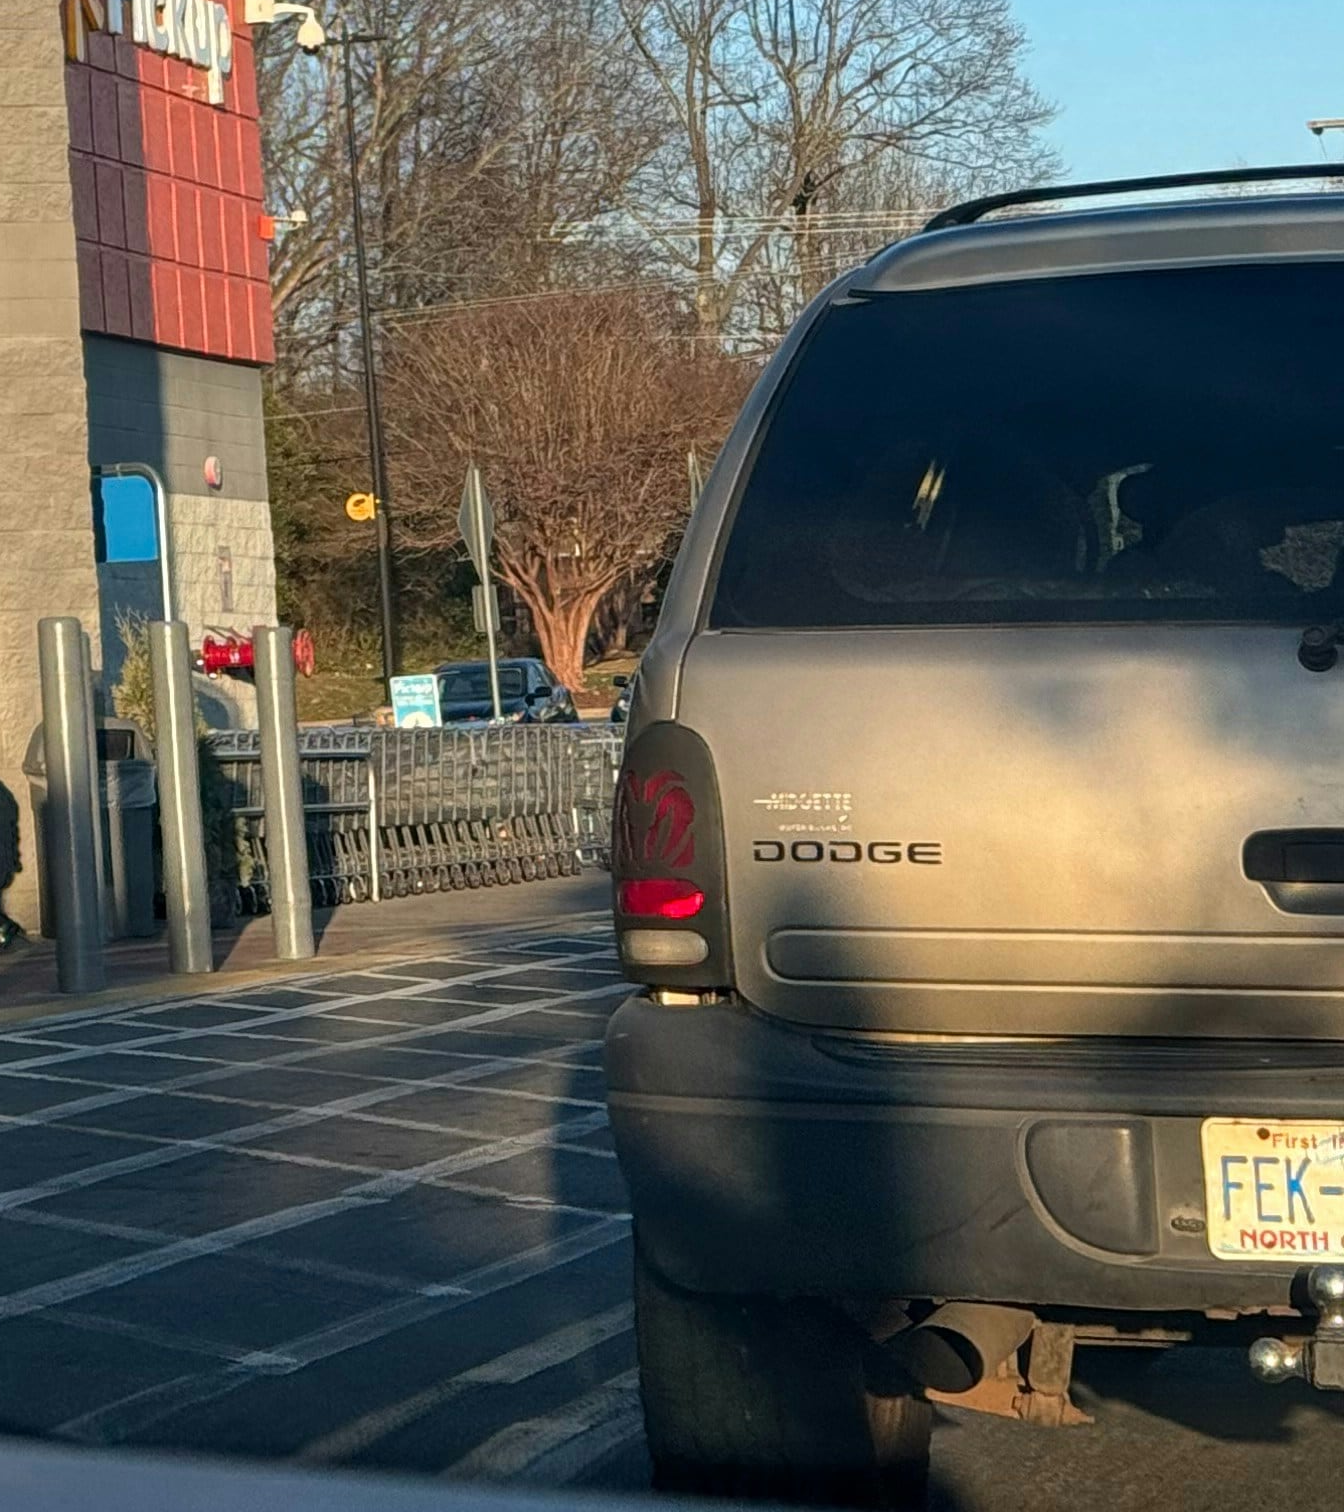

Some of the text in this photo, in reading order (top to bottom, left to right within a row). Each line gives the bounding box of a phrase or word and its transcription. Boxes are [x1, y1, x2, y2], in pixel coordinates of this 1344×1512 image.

[752, 840, 943, 865] DODGE
[1272, 1132, 1318, 1150] First
[1239, 1229, 1330, 1252] NORTH
